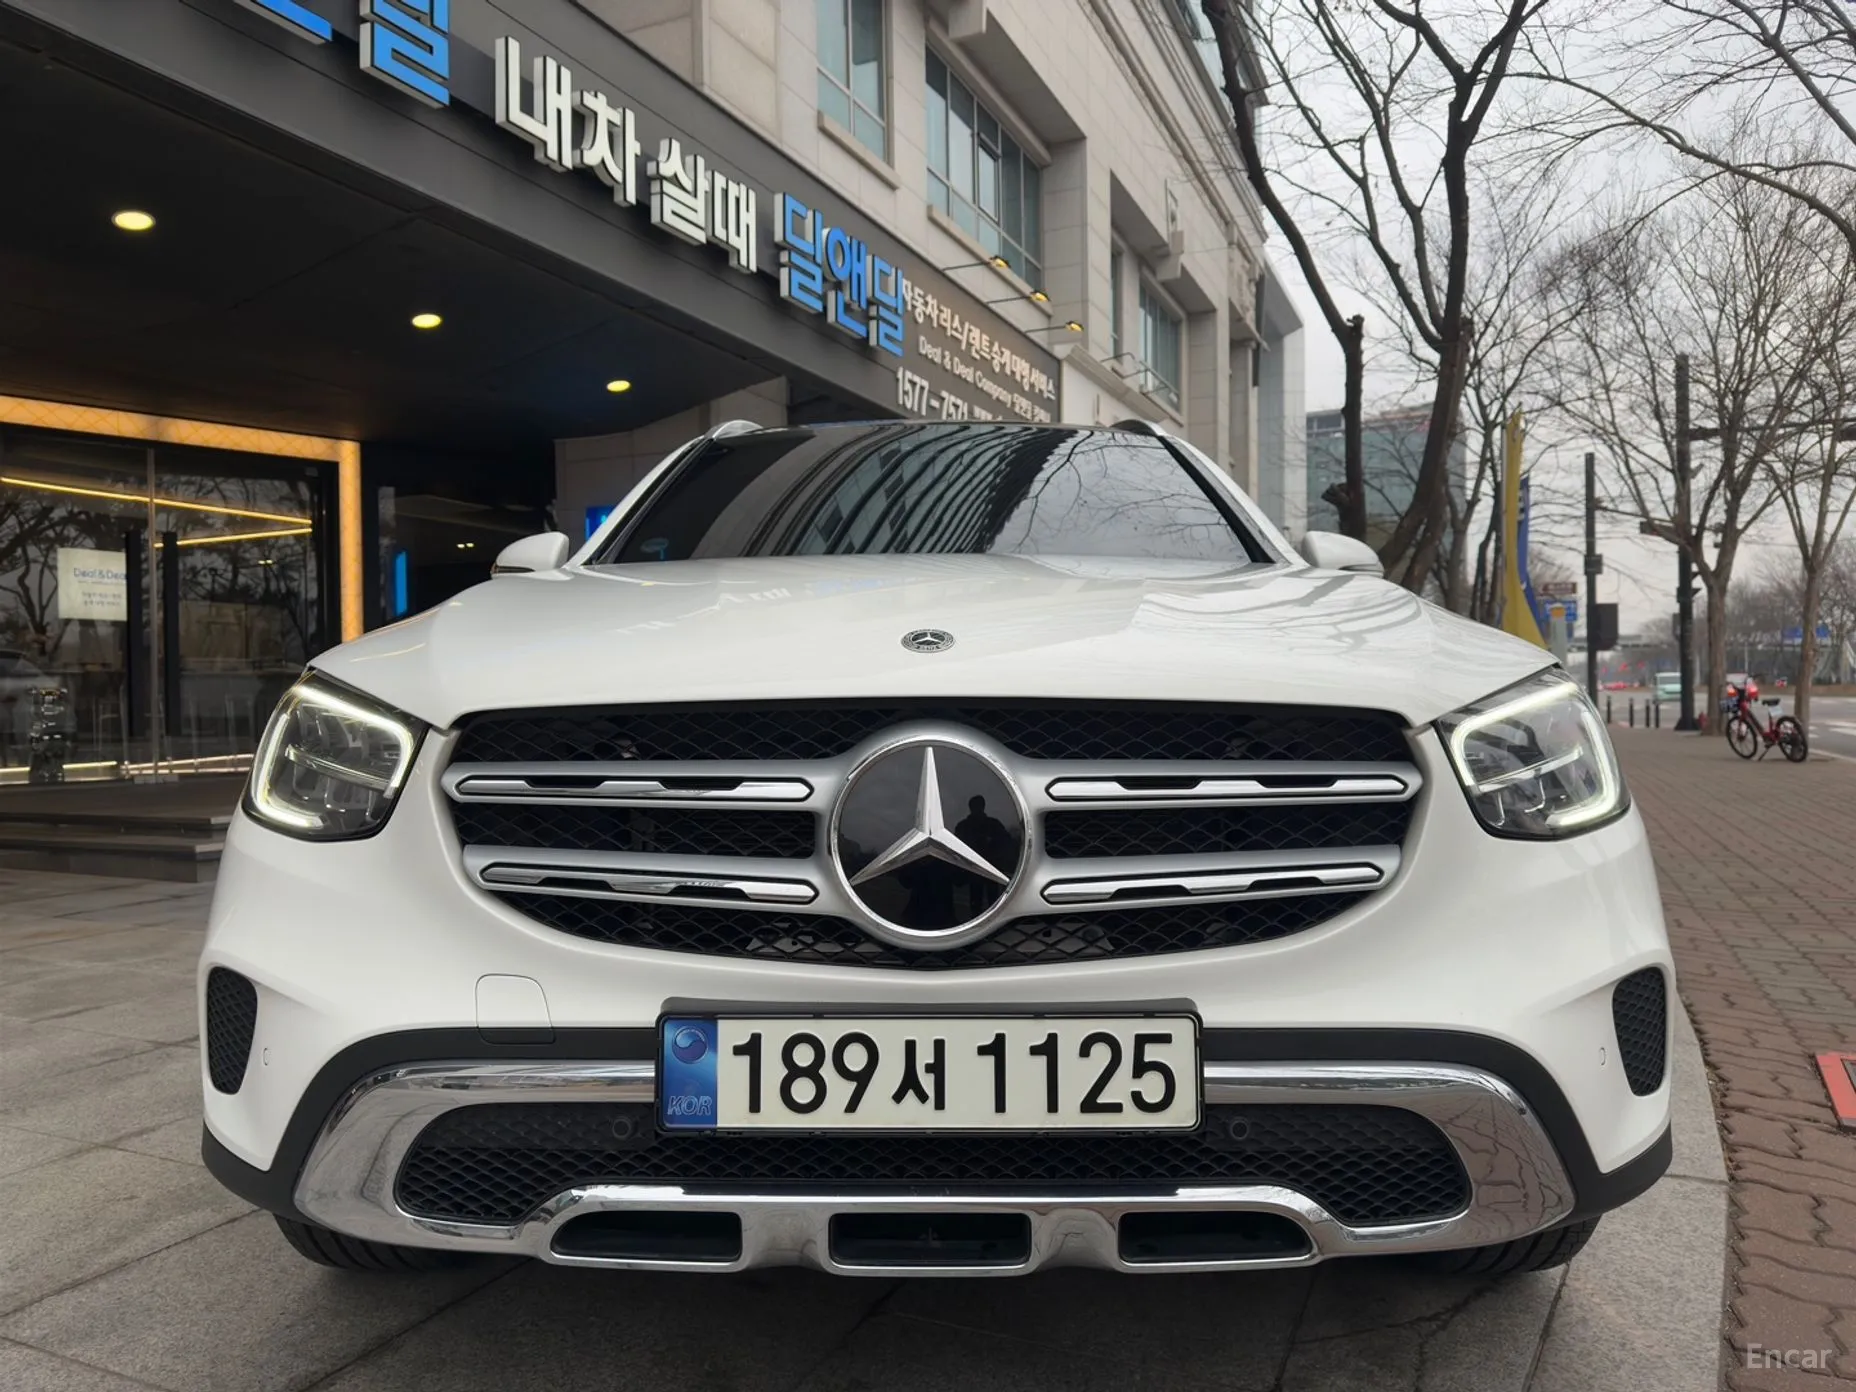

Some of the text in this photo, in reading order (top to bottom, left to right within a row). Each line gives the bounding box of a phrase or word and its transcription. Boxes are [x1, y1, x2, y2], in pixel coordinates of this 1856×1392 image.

[495, 36, 641, 207] 내차
[646, 137, 757, 274] 살때
[774, 192, 904, 357] 딜앤딜
[902, 278, 938, 328] 자동차
[918, 335, 942, 365] Deal
[953, 357, 975, 383] Deal
[732, 1031, 1176, 1114] 189서 1125
[667, 1095, 713, 1116] KOR
